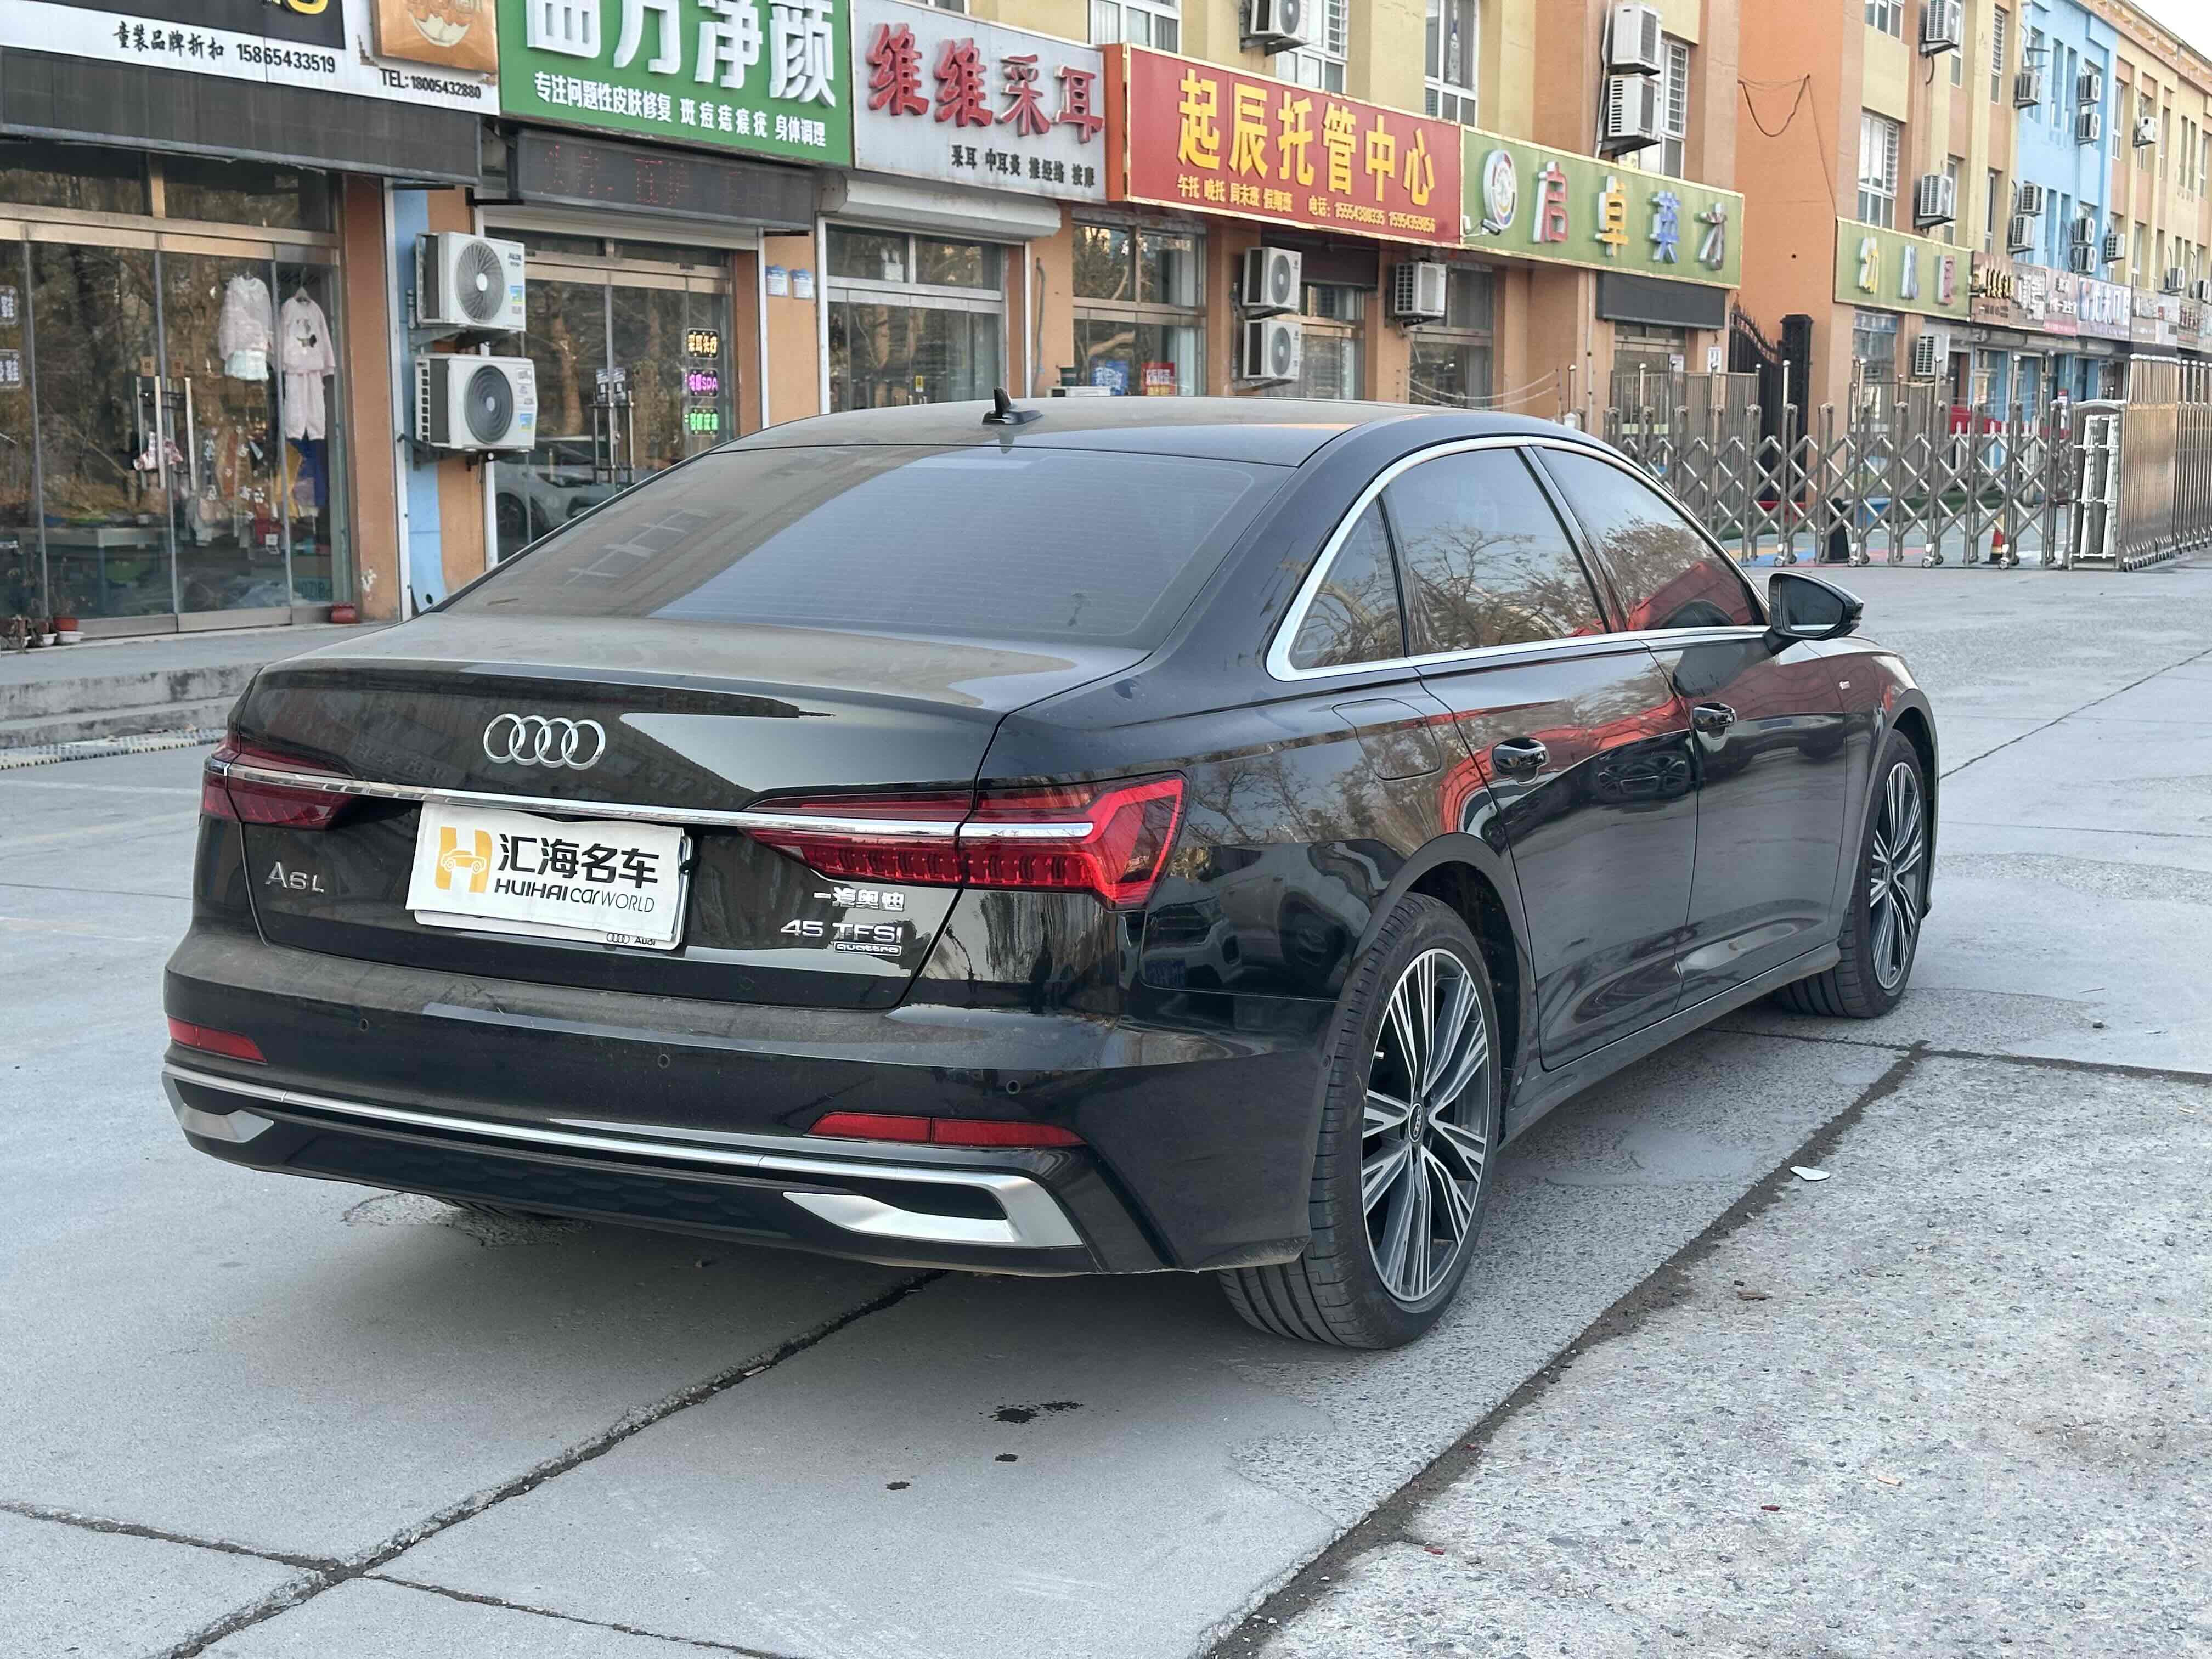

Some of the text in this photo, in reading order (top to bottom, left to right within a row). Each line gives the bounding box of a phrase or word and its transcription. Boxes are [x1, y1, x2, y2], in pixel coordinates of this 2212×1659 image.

[112, 21, 336, 73] 童装品牌折扣 15865433519
[866, 23, 1103, 143] 维维采耳
[534, 71, 672, 122] 专注问题性皮肤修复
[775, 114, 826, 147] 身体调理
[1177, 68, 1435, 206] 起辰托管中心
[952, 144, 977, 170] 采耳
[1177, 173, 1200, 199] 午托
[498, 833, 659, 888] 汇海名车
[265, 861, 324, 891] A6L
[814, 887, 905, 911] 一汽奥迪
[634, 936, 656, 946] Audi
[781, 919, 902, 943] 45 TFSI
[836, 944, 899, 953] quattro
